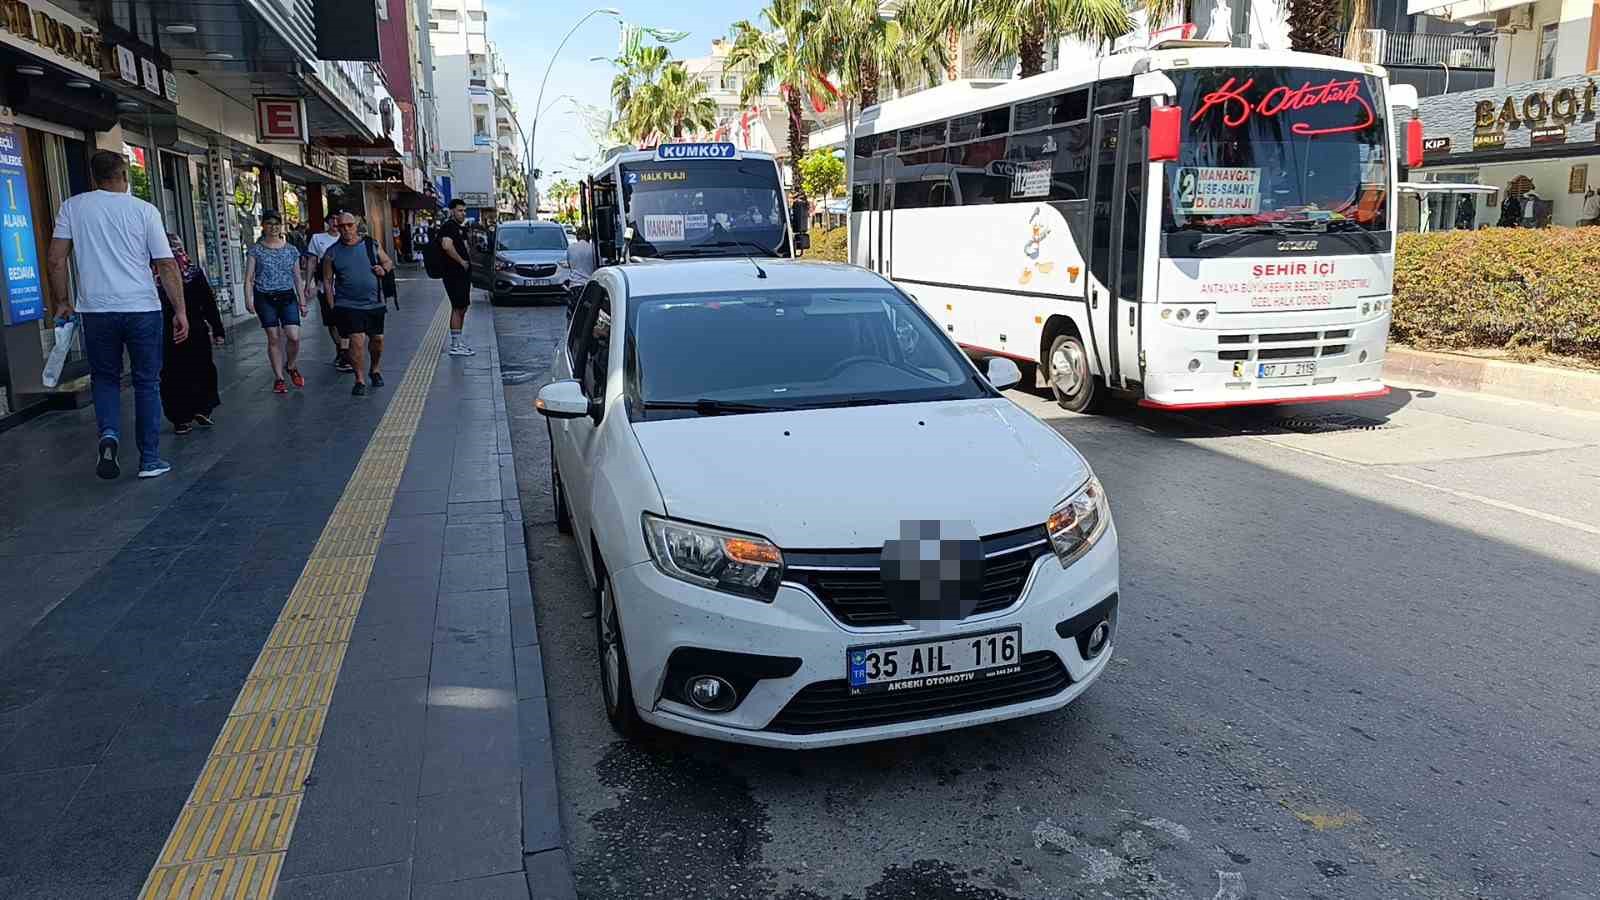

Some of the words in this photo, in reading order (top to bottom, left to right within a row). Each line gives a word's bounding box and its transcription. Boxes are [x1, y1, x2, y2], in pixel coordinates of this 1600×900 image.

[267, 105, 295, 134] E
[664, 144, 729, 158] KUMKÖY
[628, 173, 637, 183] 2
[640, 172, 662, 182] HALK
[1199, 168, 1256, 182] MANAVGAT
[1181, 174, 1196, 202] 2
[1252, 263, 1307, 279] ŞEHİR
[1313, 260, 1336, 278] İÇİ
[1200, 282, 1240, 294] ANTALYA
[1264, 365, 1276, 376] 07
[866, 650, 898, 679] 35
[911, 645, 951, 675] AIL
[972, 635, 1015, 666] 116
[853, 669, 865, 678] TR
